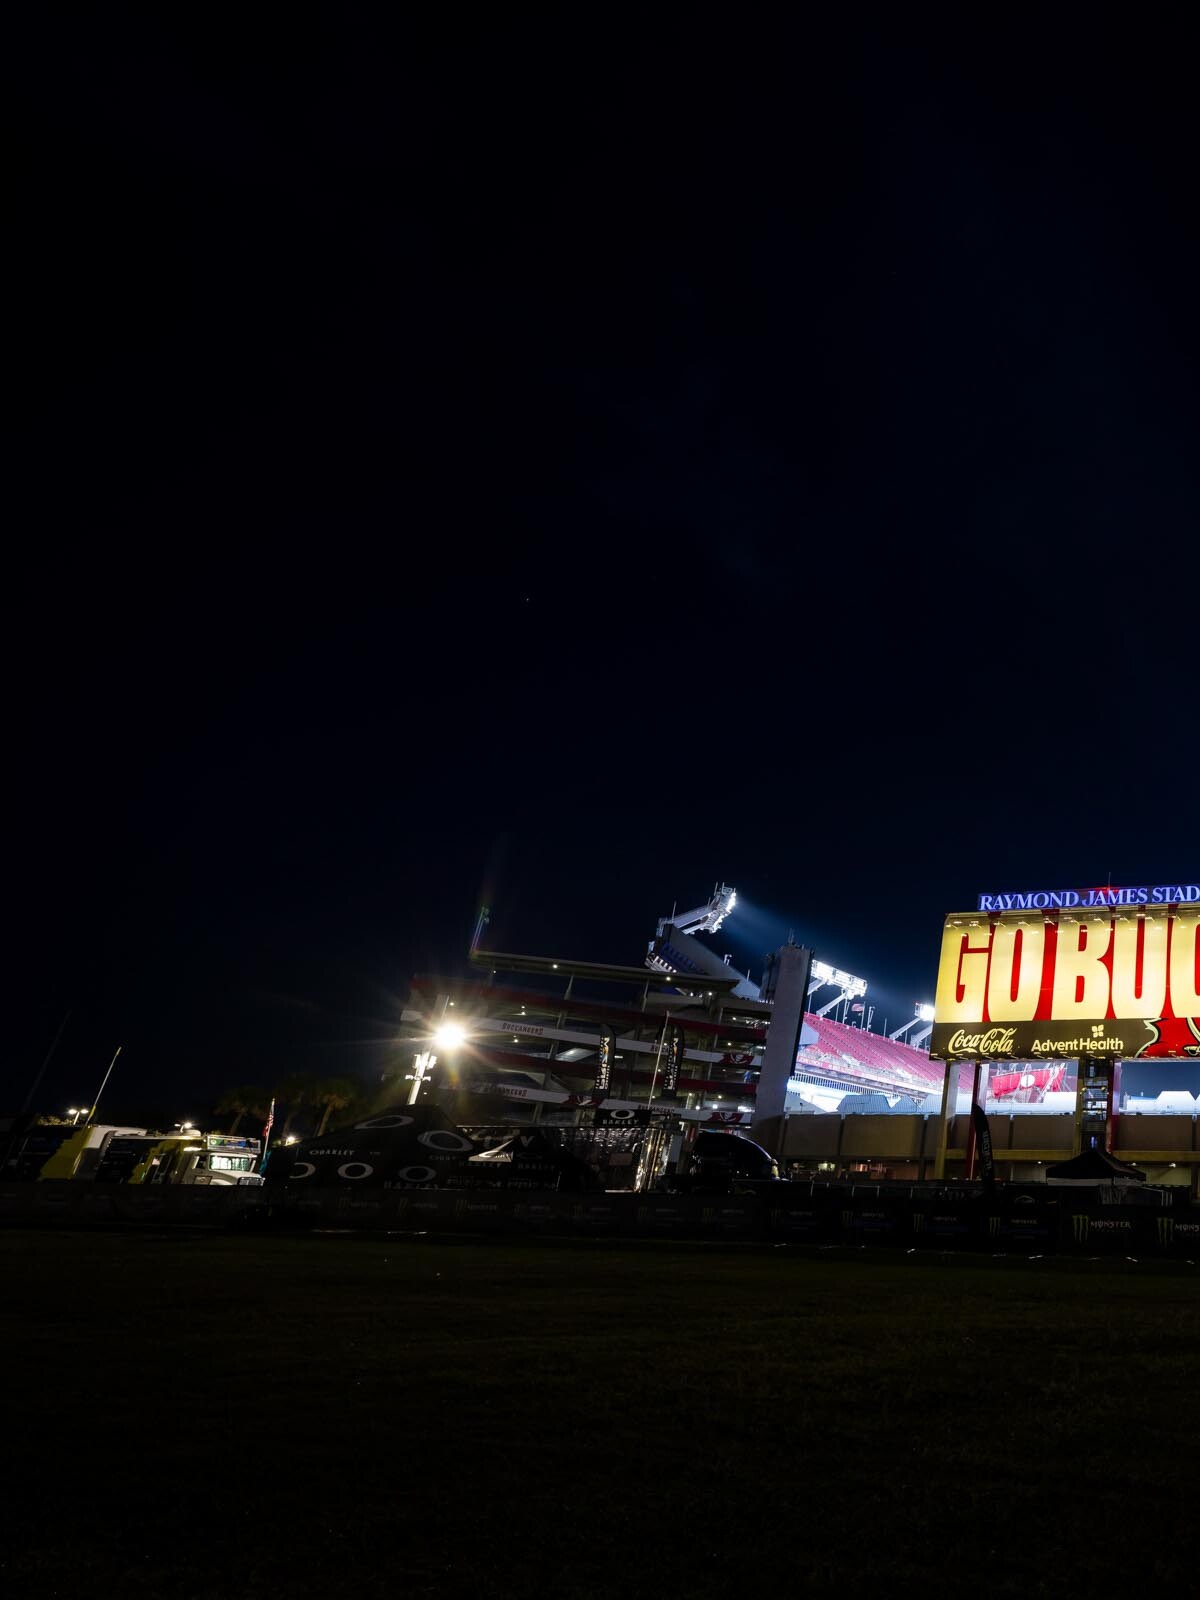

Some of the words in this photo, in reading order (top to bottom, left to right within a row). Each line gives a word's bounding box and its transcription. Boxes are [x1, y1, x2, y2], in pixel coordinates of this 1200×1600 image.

[978, 890, 1079, 911] RAYMOND
[1081, 887, 1148, 907] JAMES
[932, 917, 1045, 1023] GO
[948, 1027, 1018, 1054] Coca-Cola
[1090, 1218, 1132, 1230] MONSTER
